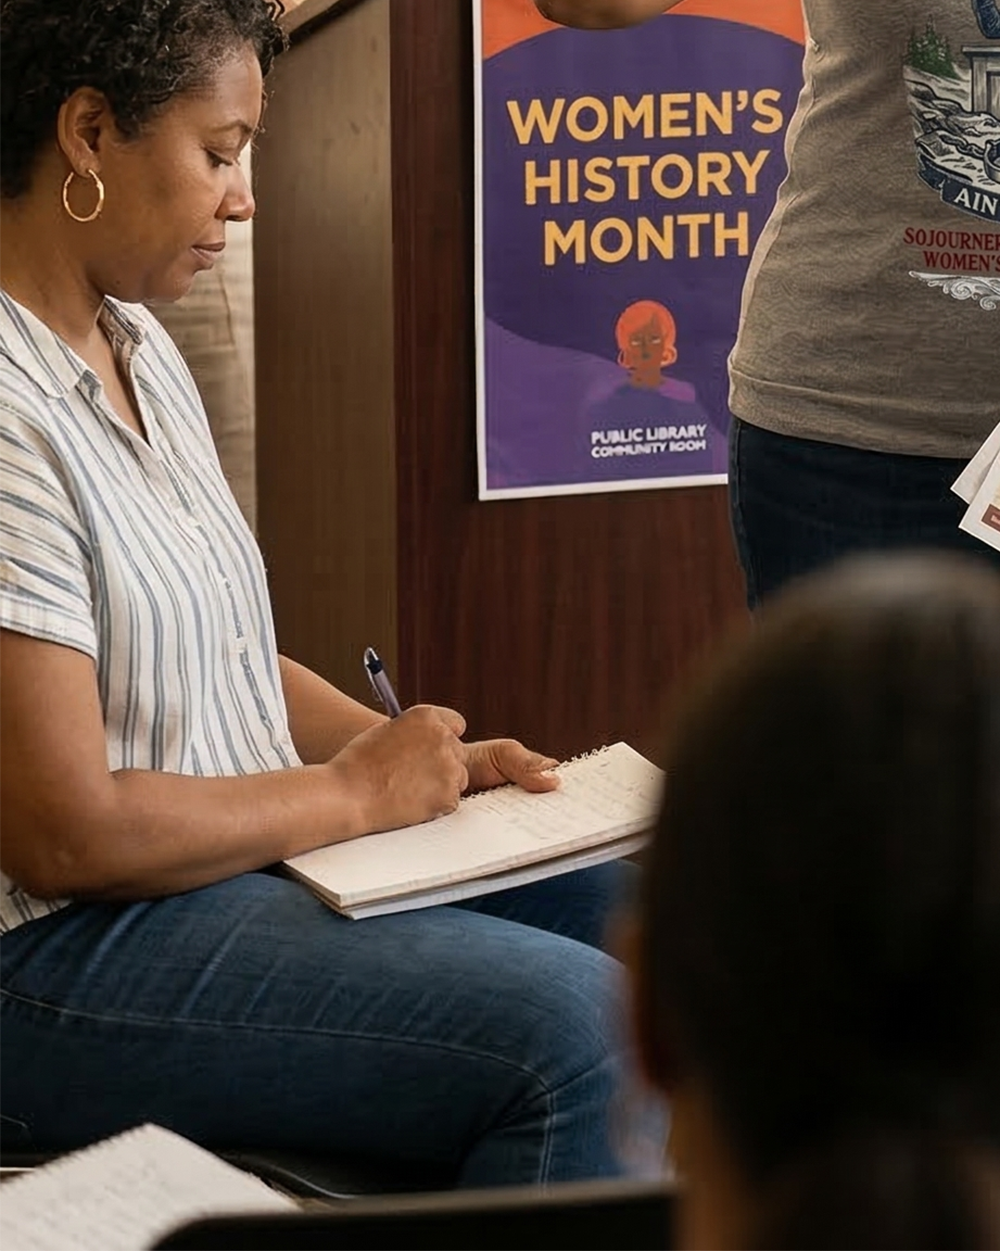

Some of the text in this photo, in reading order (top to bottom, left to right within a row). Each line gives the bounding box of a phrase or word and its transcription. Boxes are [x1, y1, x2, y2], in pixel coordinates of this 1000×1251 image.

[507, 89, 783, 144] WOMEN'S
[525, 151, 769, 205] HISTORY
[544, 212, 749, 265] MONTH
[591, 424, 707, 445] PUBLIC LIBRARY
